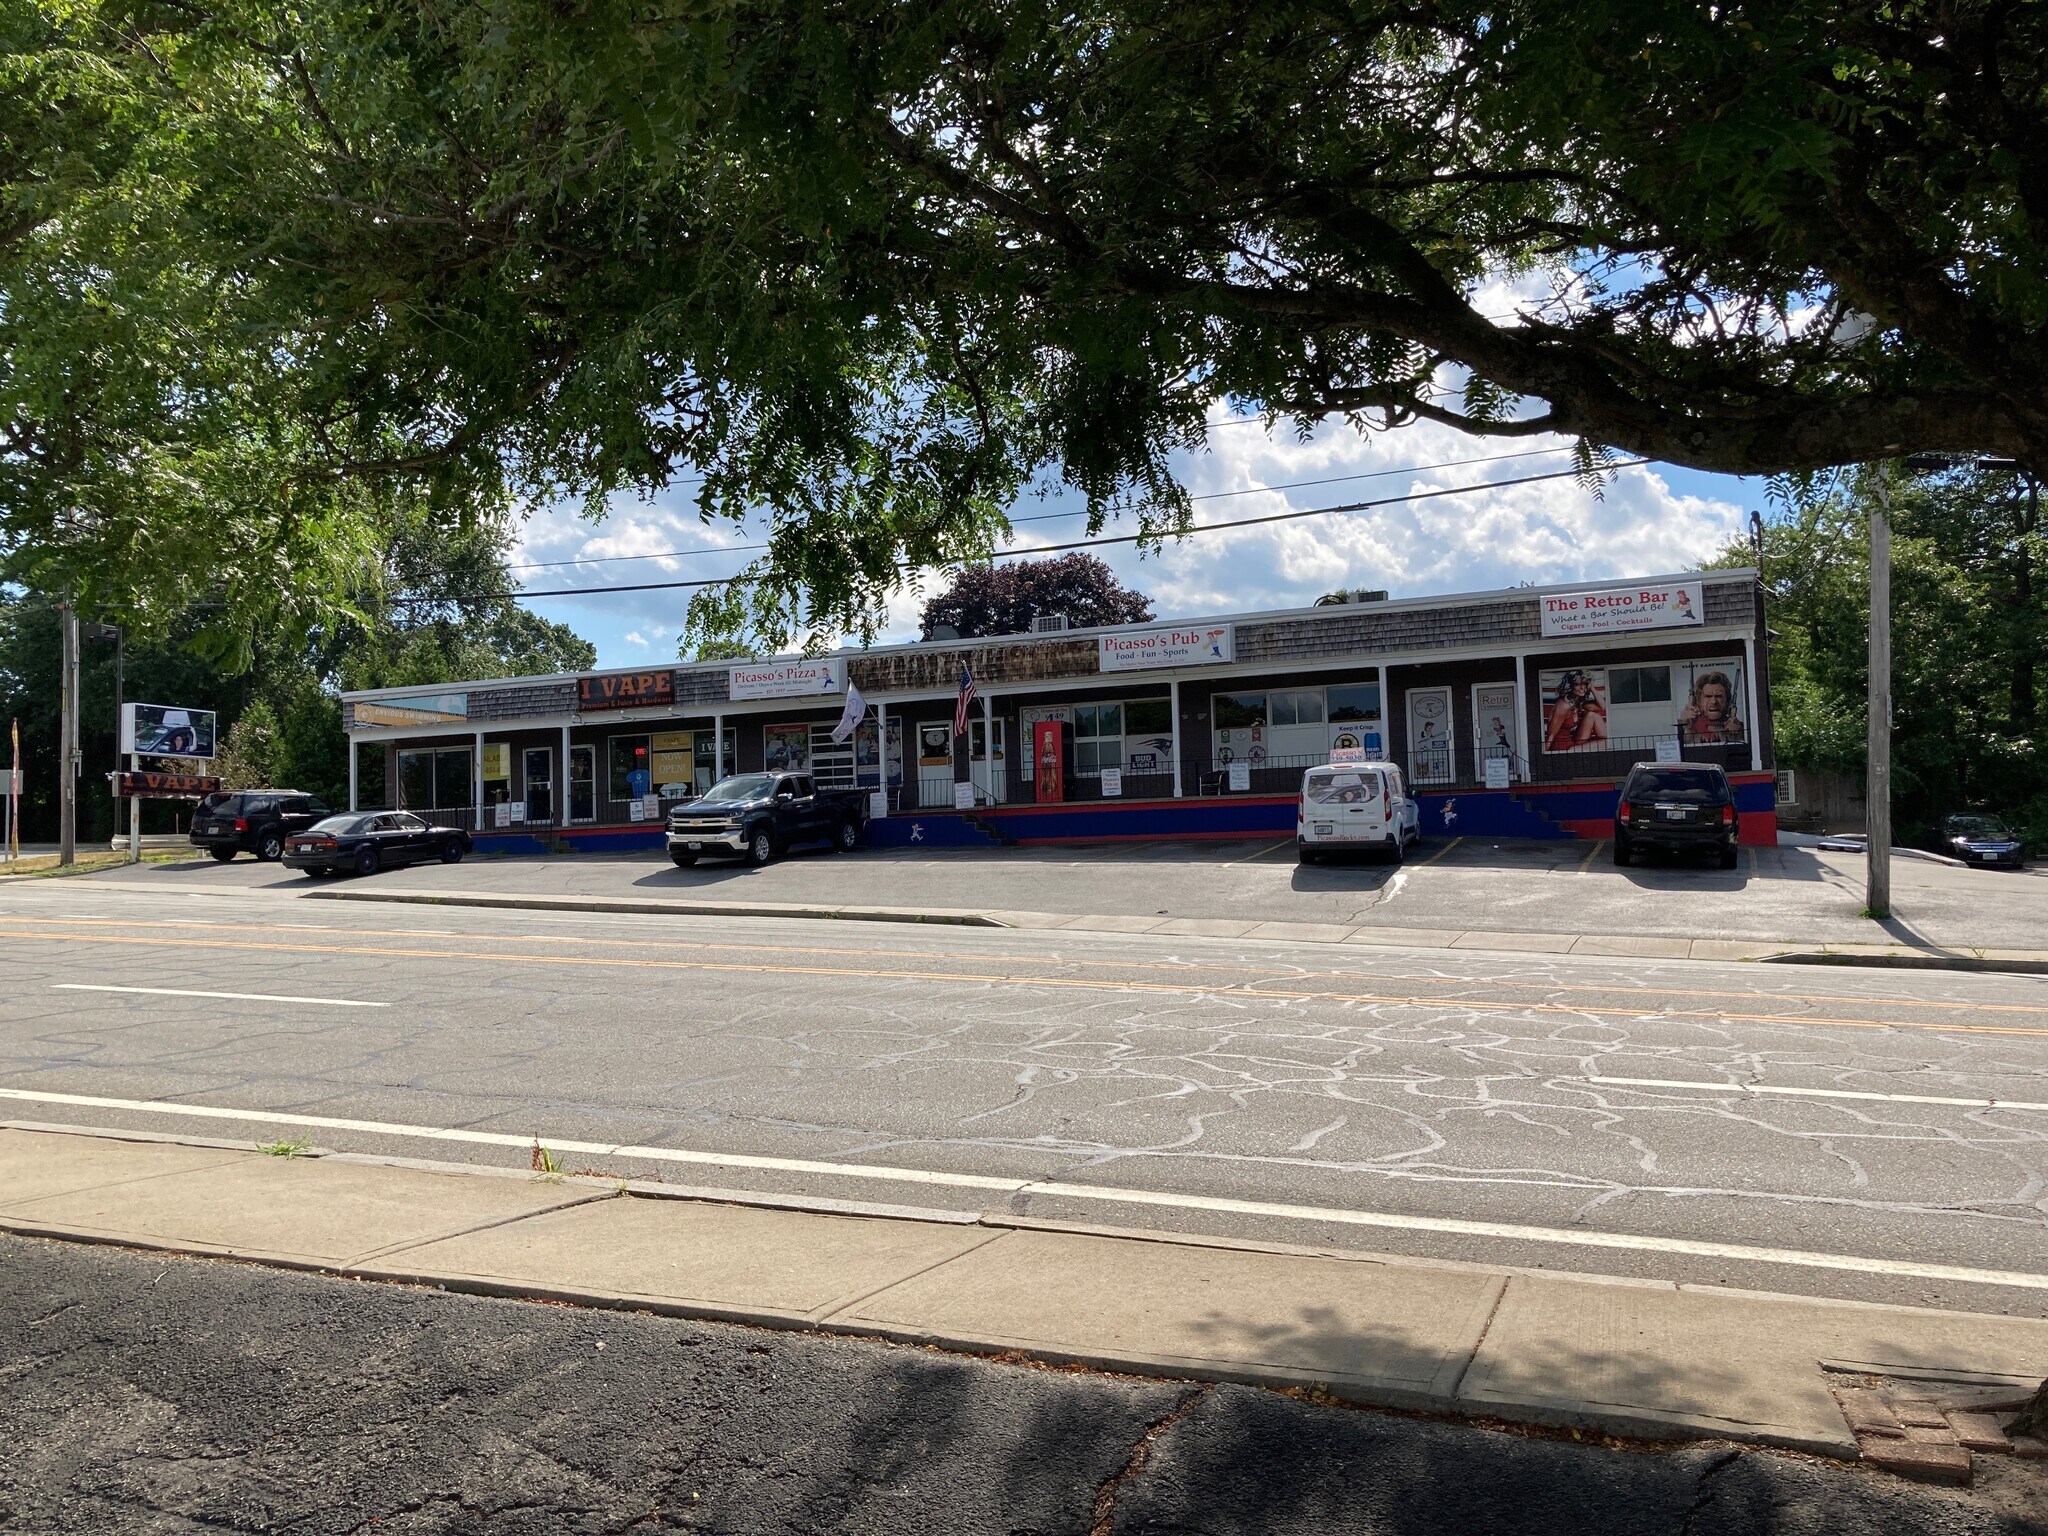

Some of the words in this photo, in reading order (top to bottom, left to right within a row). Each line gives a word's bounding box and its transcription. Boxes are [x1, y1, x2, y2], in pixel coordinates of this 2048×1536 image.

[1546, 600, 1578, 612] The
[1584, 595, 1633, 609] Retro
[1638, 591, 1669, 604] Bar
[1551, 615, 1578, 624] What
[1590, 611, 1607, 619] Bar
[1610, 605, 1647, 617] Should
[1650, 603, 1665, 612] Be!
[1561, 622, 1585, 631] Cigars
[1592, 620, 1609, 628] Pool
[1616, 617, 1653, 626] Cocktails
[1104, 634, 1167, 651] Picasso's
[1171, 631, 1200, 645] Pub
[1116, 652, 1135, 660] Food
[1141, 650, 1156, 658] Fun
[1163, 648, 1189, 658] Sports
[734, 669, 784, 684] Picasso's
[786, 667, 816, 680] Pizza
[581, 680, 591, 699] I
[600, 672, 671, 698] VAPE
[581, 701, 609, 710] Premium
[1482, 695, 1510, 705] Retro
[375, 708, 403, 718] ENVIOUS
[405, 712, 442, 722] SWIMMING
[1359, 724, 1375, 732] Crisp.
[707, 742, 730, 751] VAE
[1331, 748, 1362, 757] Picasso's
[661, 752, 683, 761] NOW
[659, 763, 686, 775] OPEN!
[1132, 761, 1155, 769] LIGHT
[145, 774, 215, 791] VAPE
